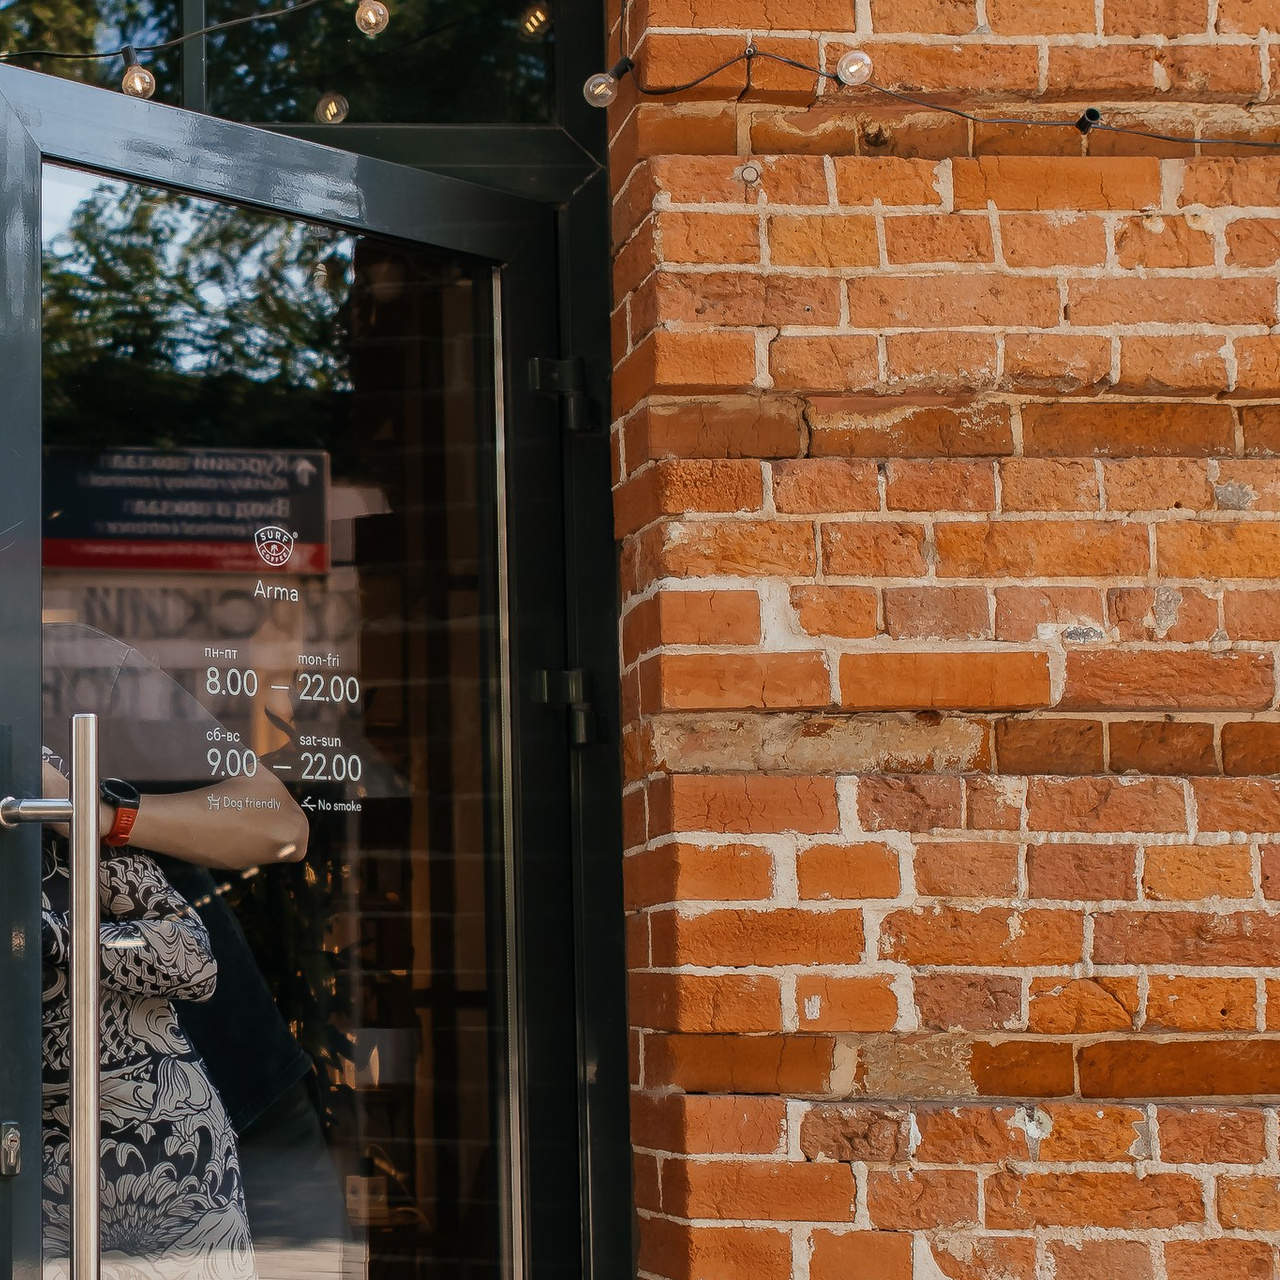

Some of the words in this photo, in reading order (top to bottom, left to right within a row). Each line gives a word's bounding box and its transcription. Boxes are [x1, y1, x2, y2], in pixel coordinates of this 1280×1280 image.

[260, 530, 289, 543] SURF
[261, 549, 288, 563] COFFEE
[254, 580, 299, 602] Arma
[204, 647, 238, 660] пн-пт
[298, 653, 340, 667] mon-fri
[206, 666, 258, 697] 8.00
[299, 673, 360, 704] 22.00
[206, 728, 240, 742] сб-вс
[299, 734, 342, 748] sat-sun
[206, 748, 258, 778] 9.00
[300, 752, 362, 782] 22.00
[223, 797, 243, 811] Dog
[245, 796, 281, 811] friendly
[318, 799, 332, 811] No
[333, 801, 362, 812] smoke
